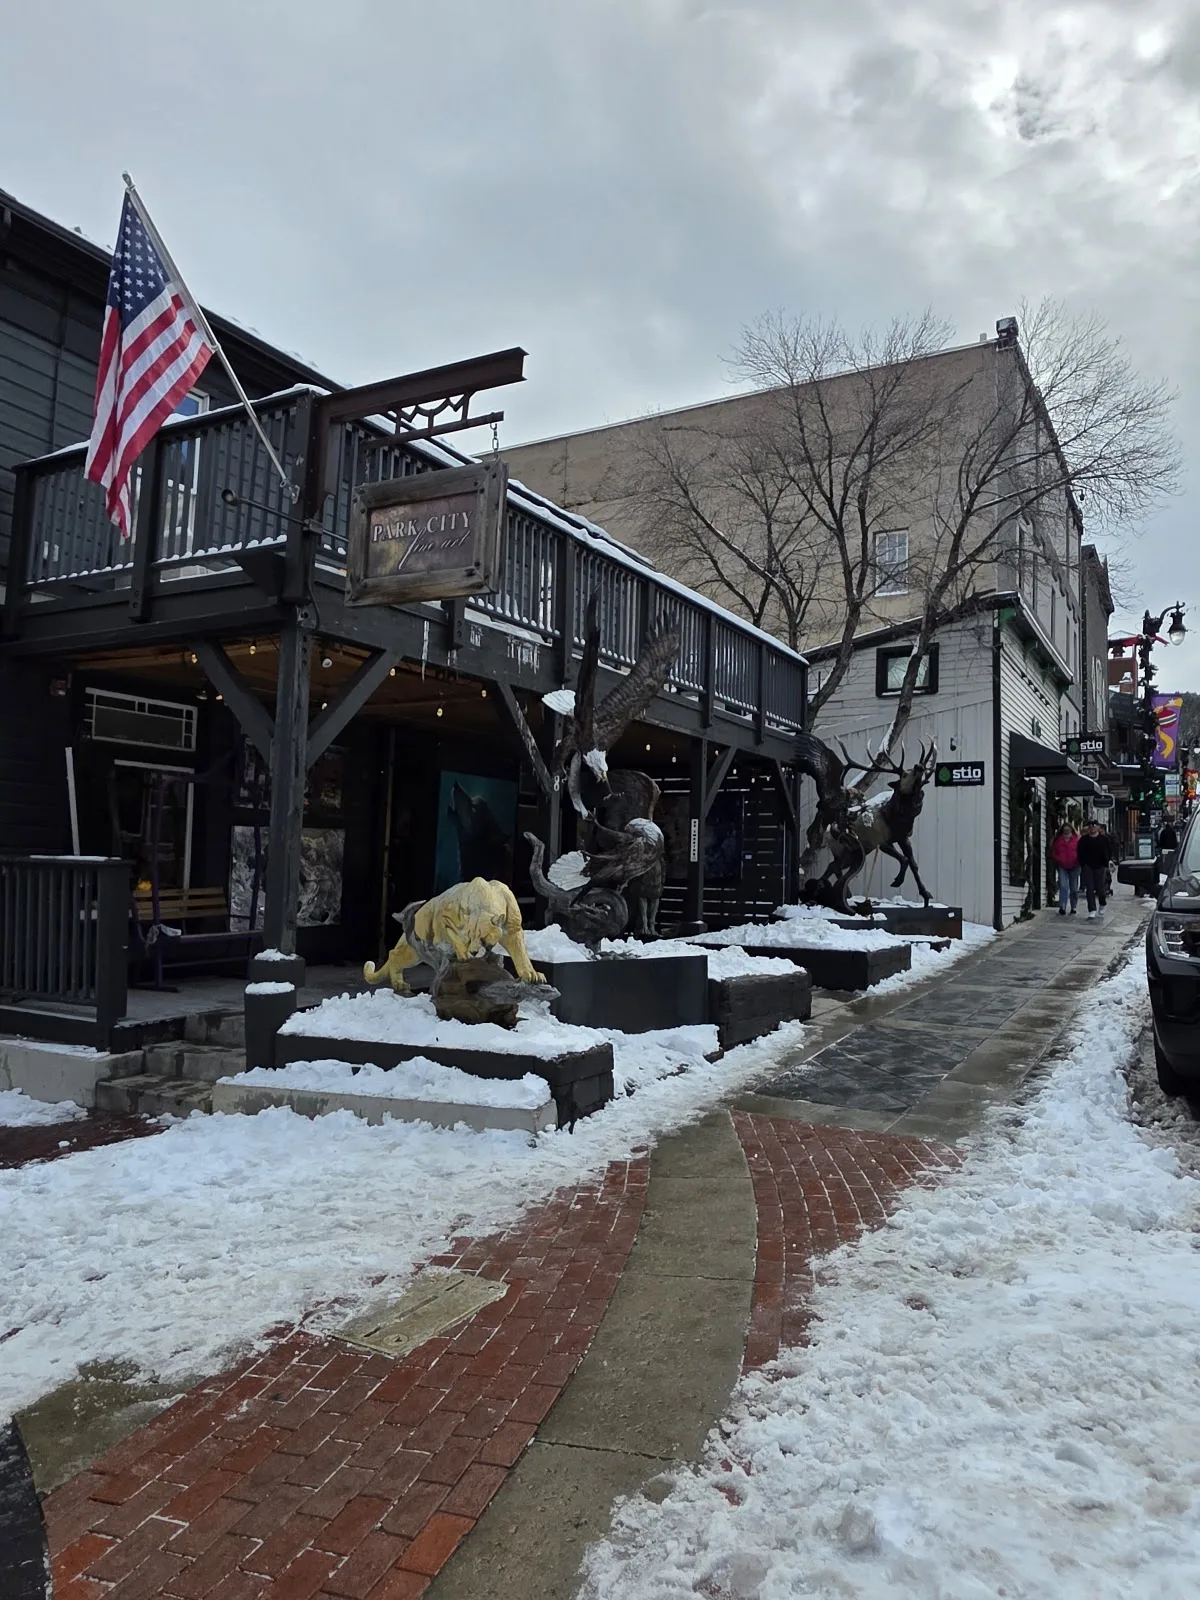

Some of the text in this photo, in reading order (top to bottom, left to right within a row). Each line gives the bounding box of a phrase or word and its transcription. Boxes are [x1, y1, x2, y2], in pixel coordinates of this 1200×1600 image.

[373, 511, 473, 542] PARK CITY
[398, 527, 471, 570] fine art
[1080, 740, 1103, 750] stio
[952, 766, 982, 779] stio
